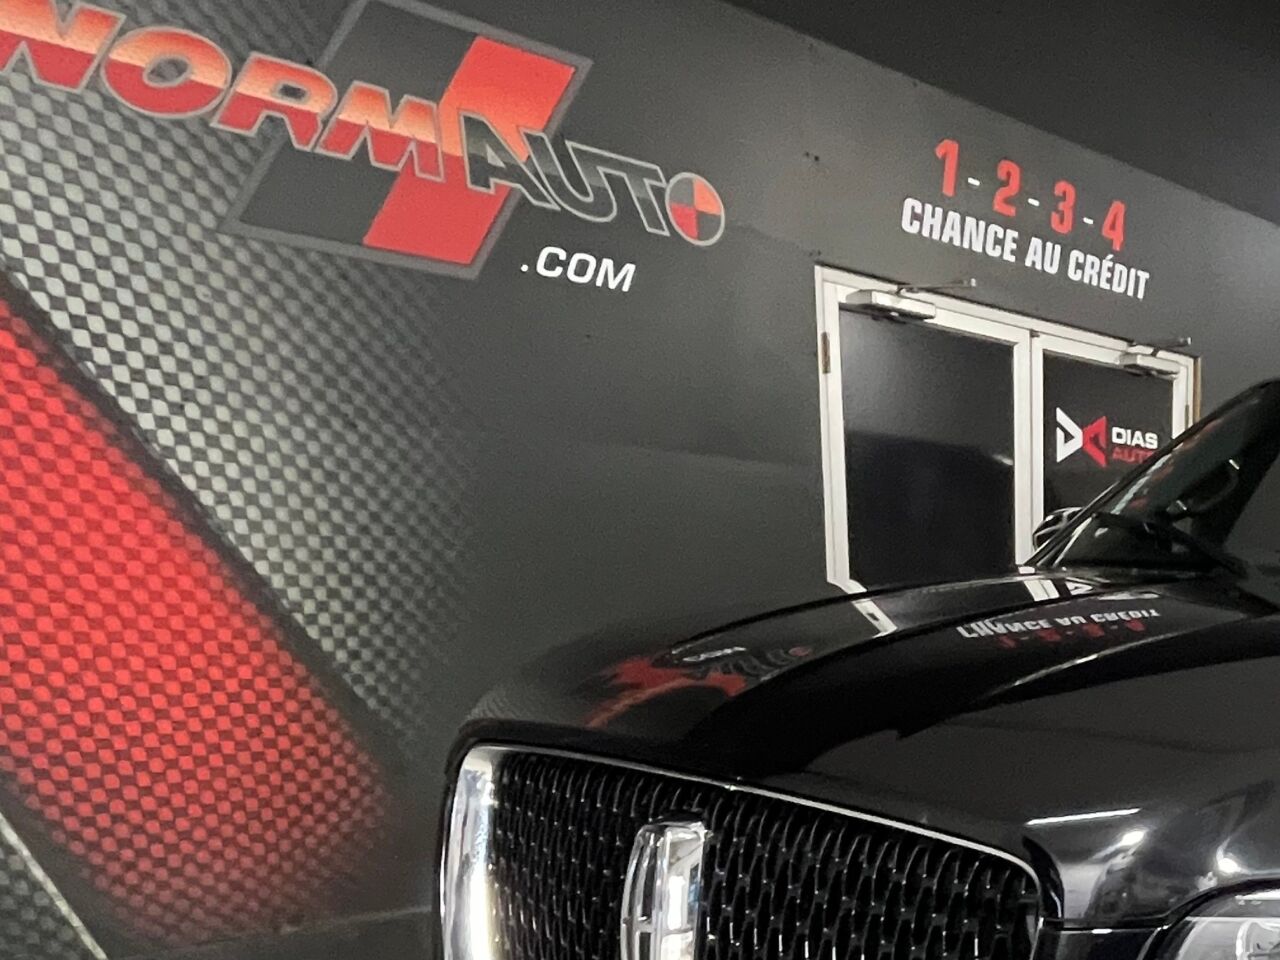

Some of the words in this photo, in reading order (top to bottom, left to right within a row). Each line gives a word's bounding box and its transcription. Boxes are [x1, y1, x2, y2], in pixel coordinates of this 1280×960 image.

[901, 197, 1019, 263] CHANCE
[1024, 236, 1062, 275] AU
[1067, 249, 1150, 300] CRÉDIT
[520, 246, 636, 293] .COM
[1112, 426, 1159, 450] DIAS
[1112, 447, 1154, 464] AUT
